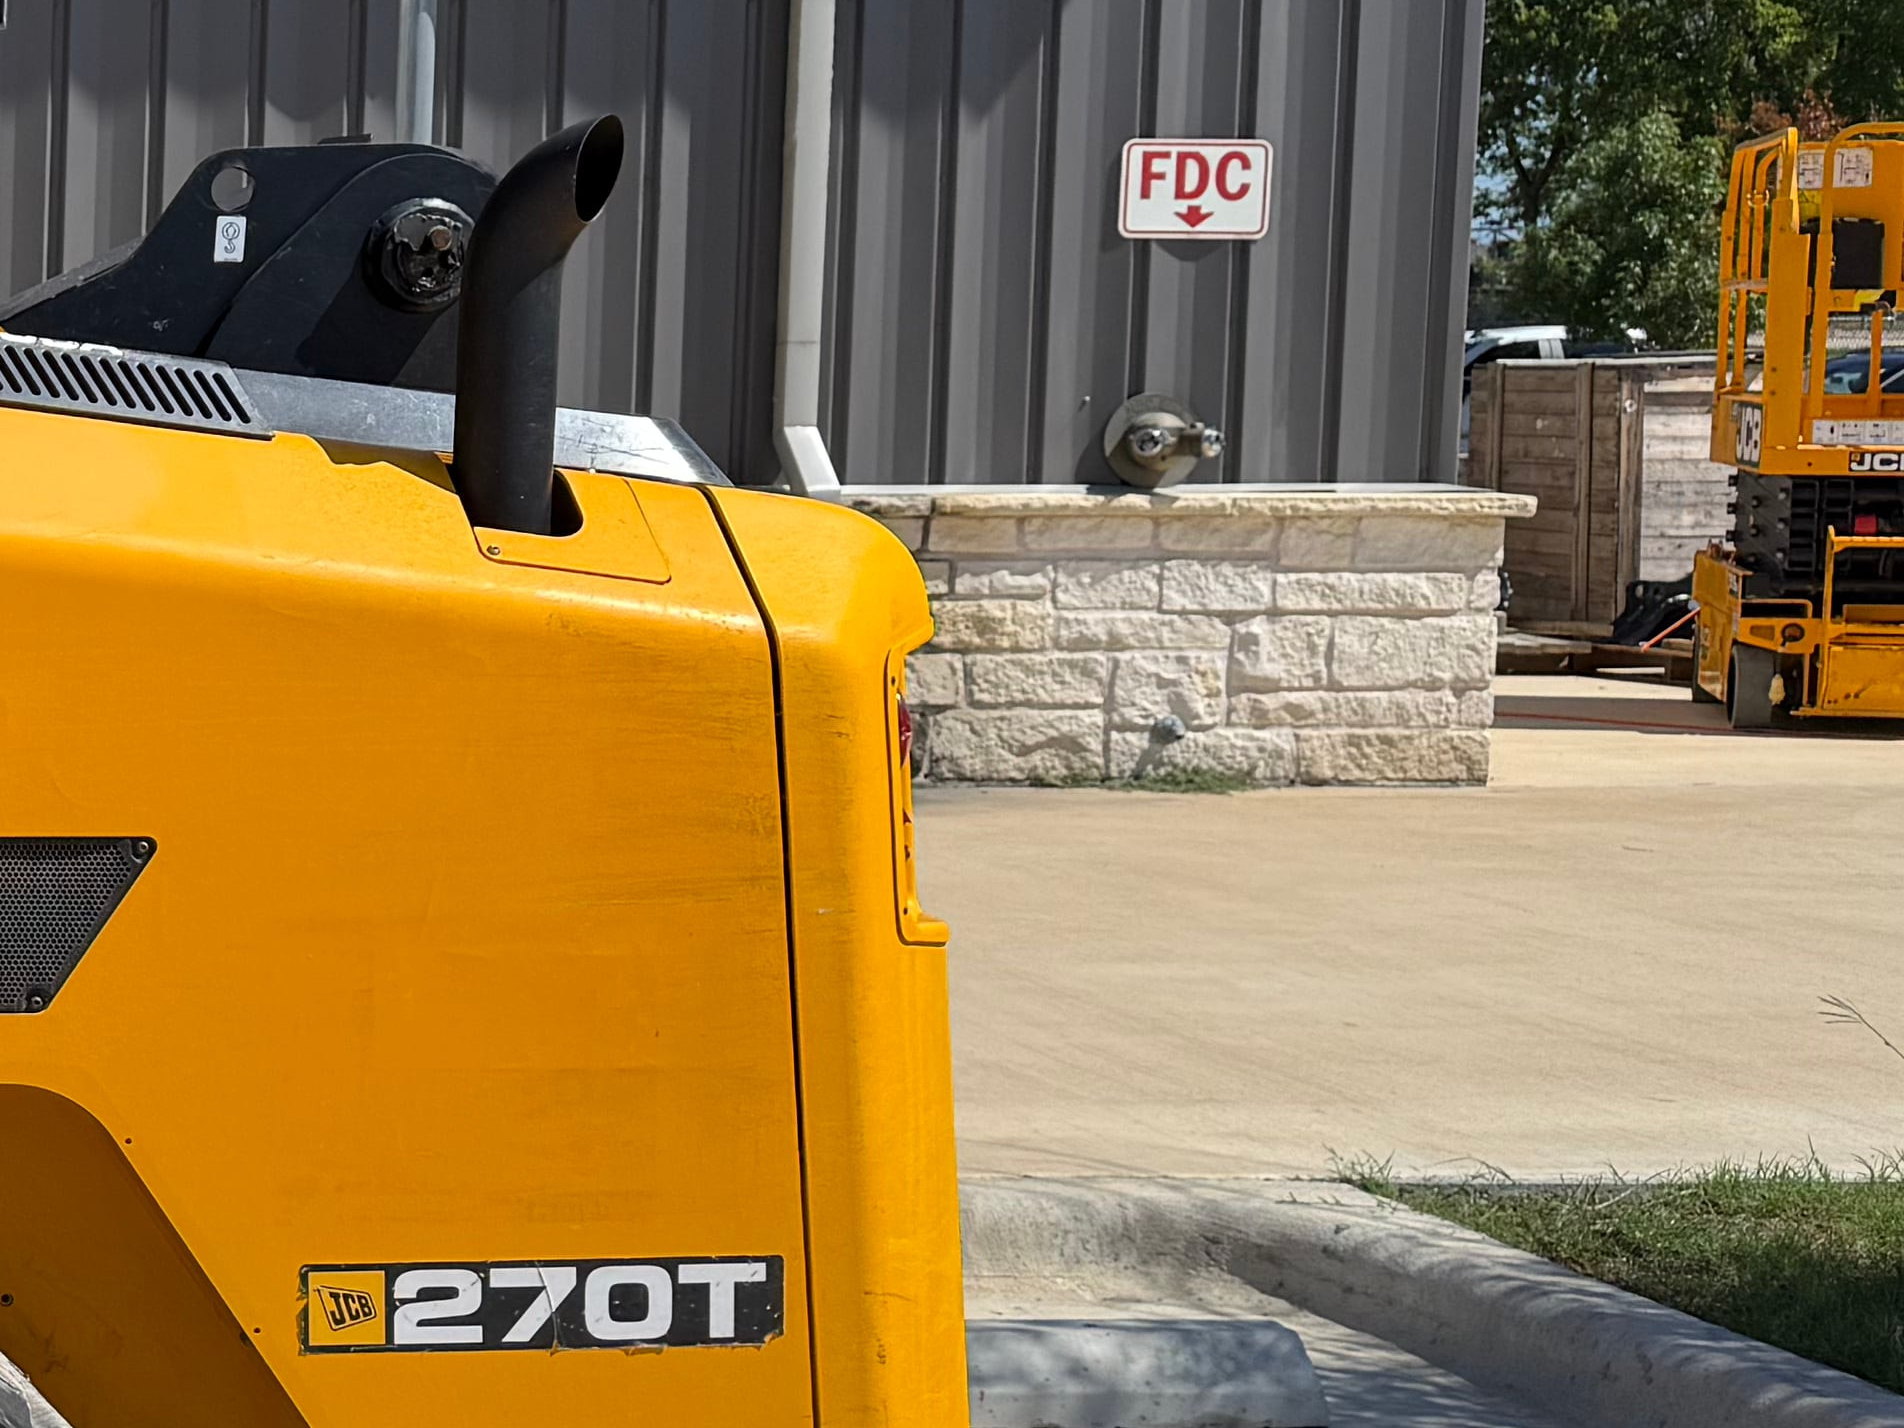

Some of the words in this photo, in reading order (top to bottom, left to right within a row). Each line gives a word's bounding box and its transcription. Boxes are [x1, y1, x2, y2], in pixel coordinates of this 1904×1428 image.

[1139, 151, 1252, 201] FDC
[1850, 453, 1904, 471] JC
[328, 1291, 373, 1326] JCB
[393, 1263, 767, 1345] 270T
